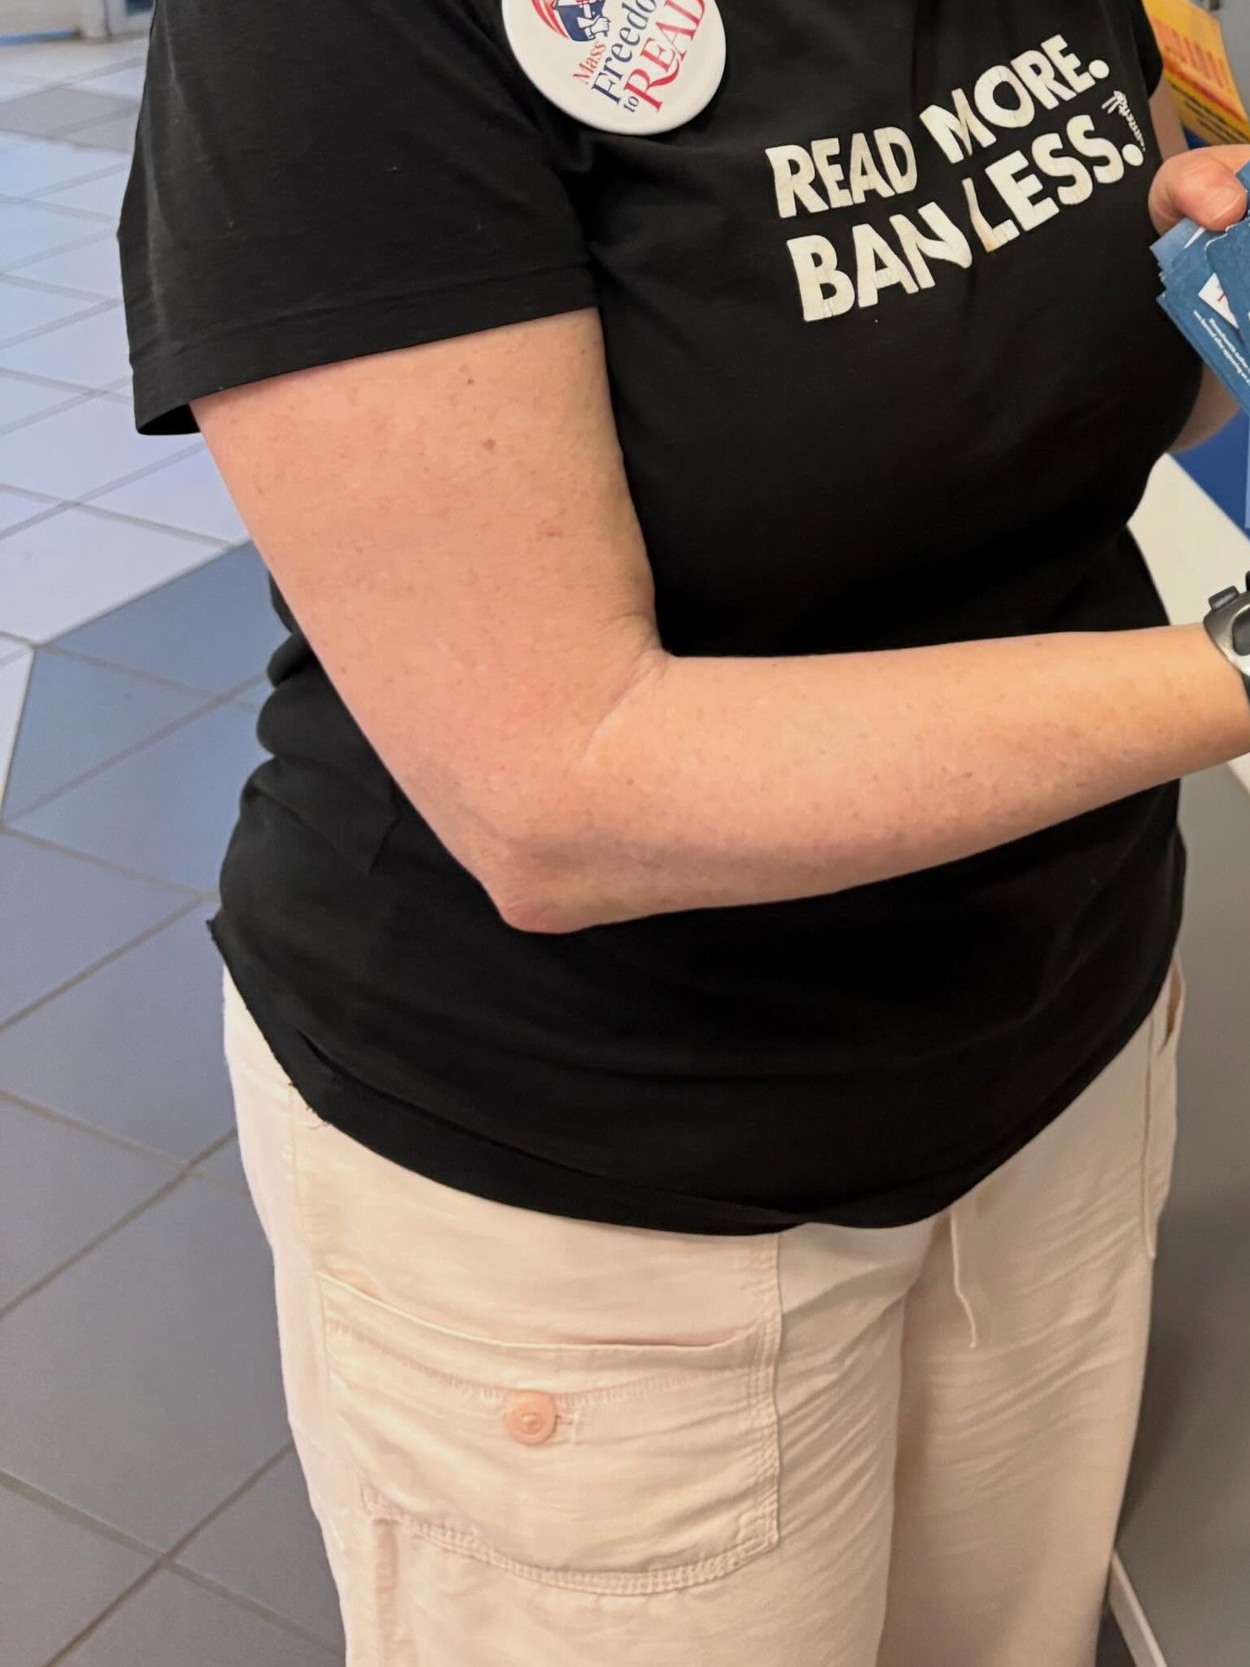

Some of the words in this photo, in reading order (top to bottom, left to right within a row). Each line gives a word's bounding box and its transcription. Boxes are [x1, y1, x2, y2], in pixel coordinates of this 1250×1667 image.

[573, 40, 607, 85] Mass
[623, 96, 640, 113] to
[764, 126, 918, 219] READ
[919, 34, 1110, 164] MORE.
[786, 201, 973, 322] BAN
[961, 114, 1144, 254] LESS.
